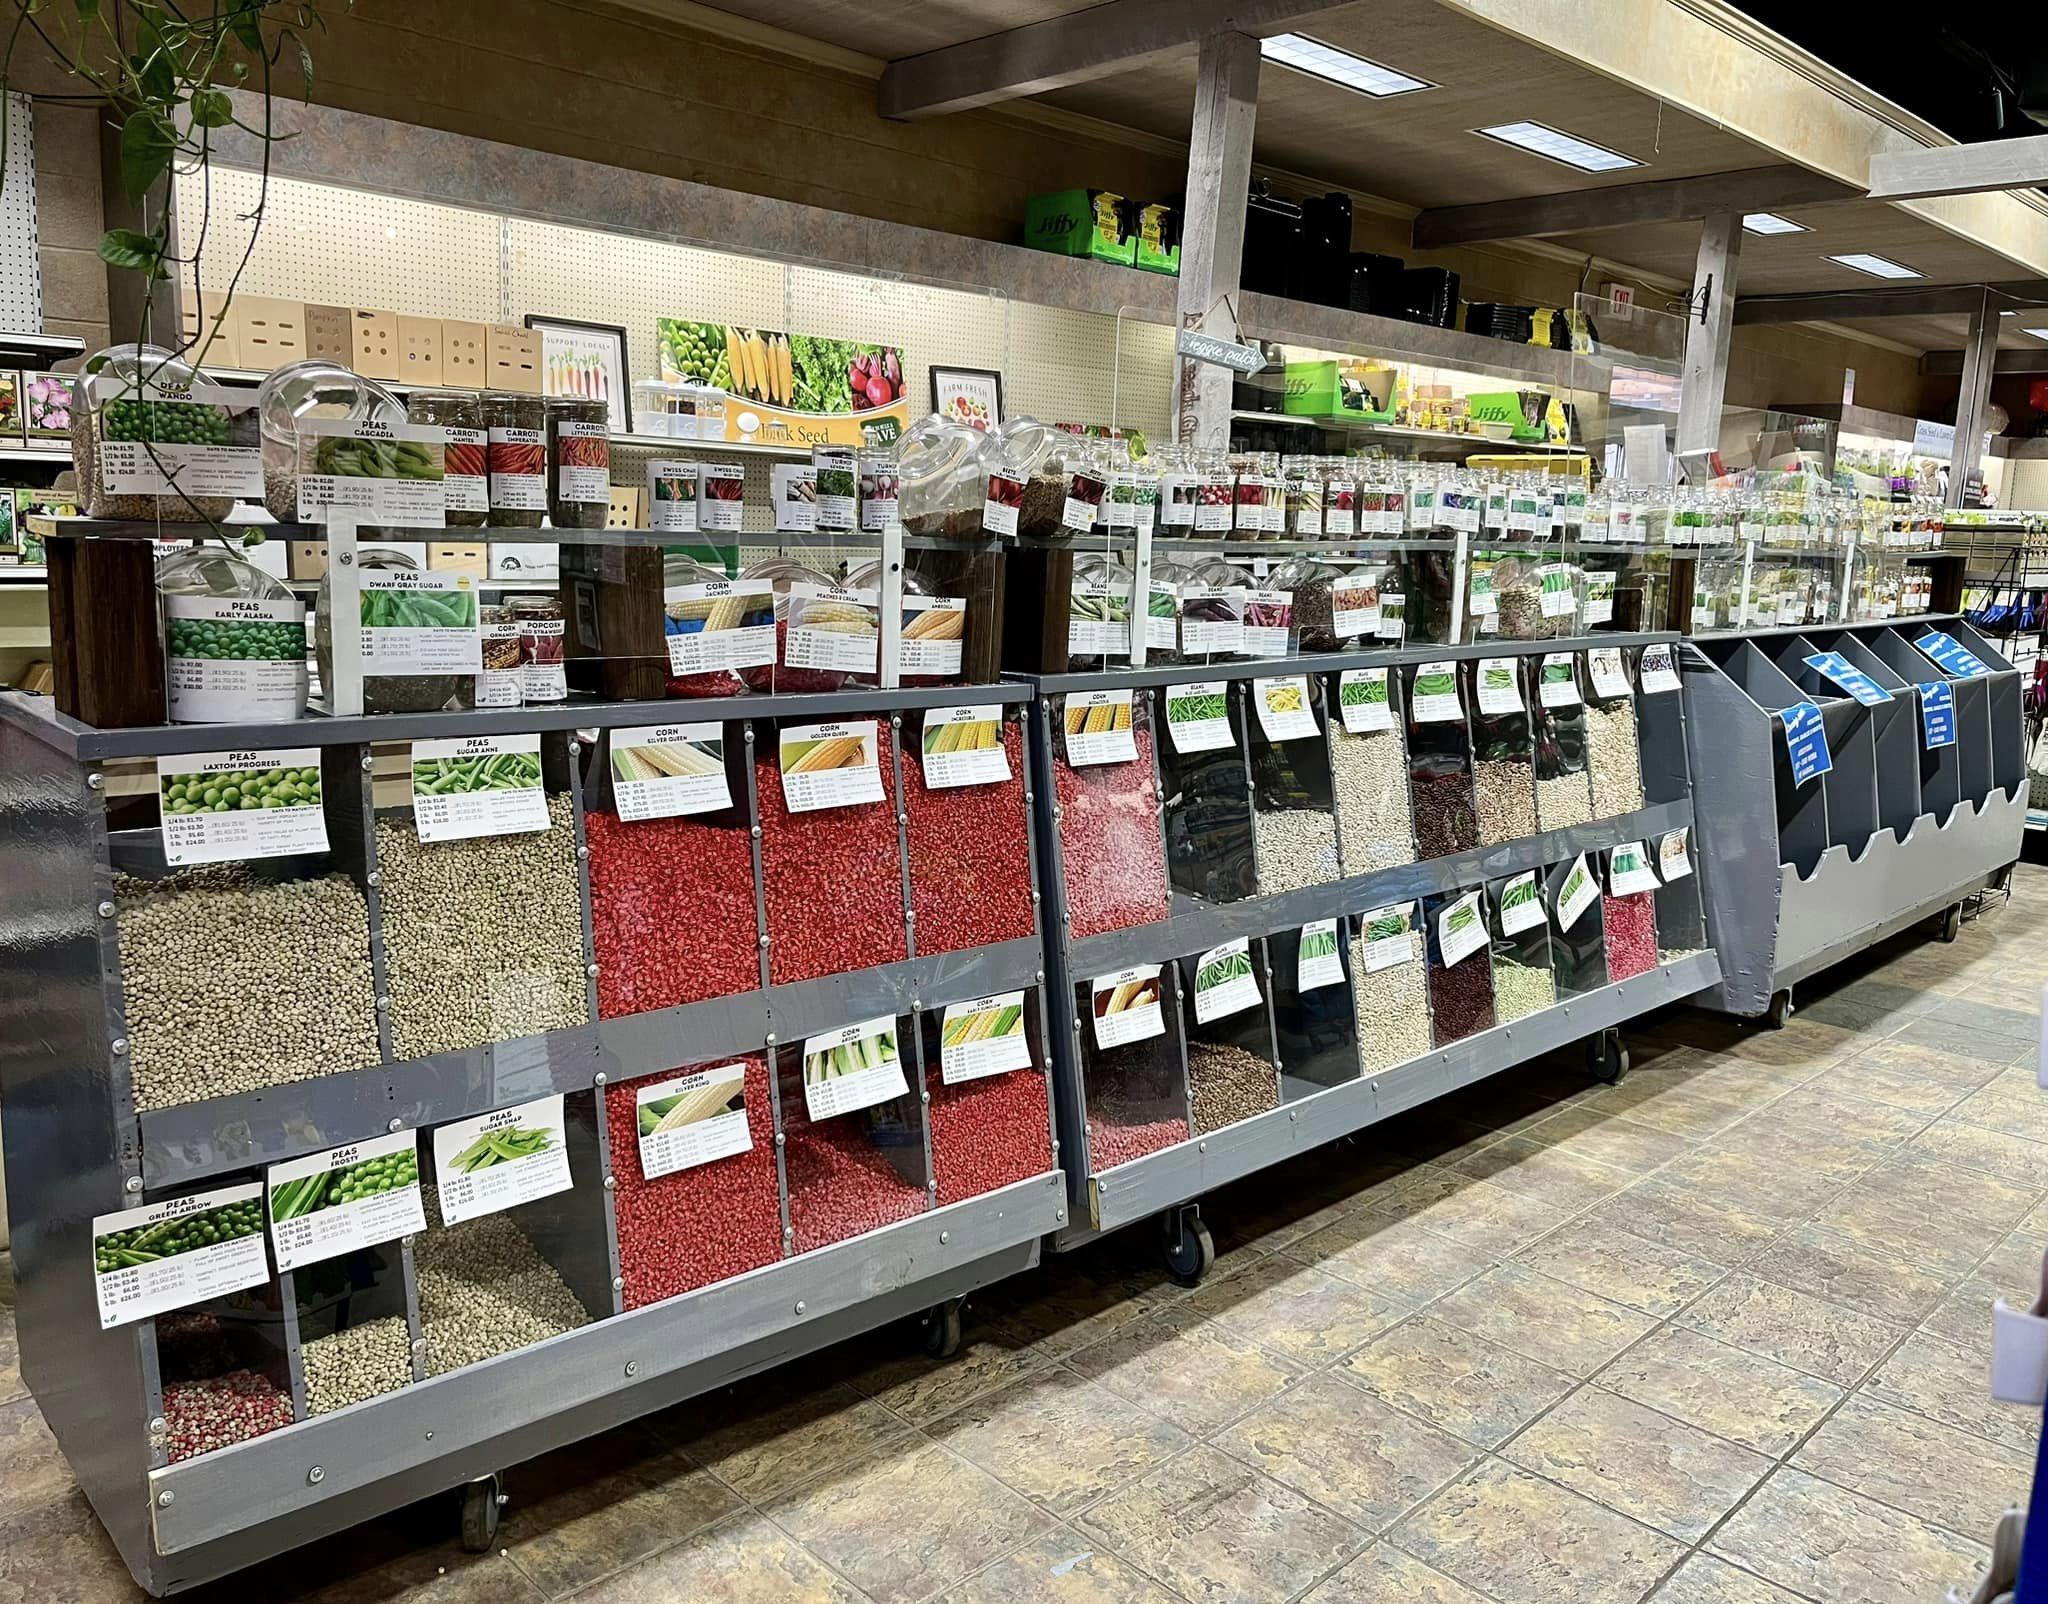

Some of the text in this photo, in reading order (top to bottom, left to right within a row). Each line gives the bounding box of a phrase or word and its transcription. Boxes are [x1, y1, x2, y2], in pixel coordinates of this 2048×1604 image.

[1036, 213, 1079, 234] Jiffy
[546, 337, 578, 347] SUPPORT
[1224, 350, 1258, 367] patch
[944, 383, 987, 397] FARM FRESH
[159, 392, 193, 400] WANDO
[1474, 407, 1513, 422] Jiffy
[362, 421, 388, 430] PEAS
[575, 424, 606, 433] CARROTS
[354, 430, 394, 438] CASCADIA
[446, 429, 479, 438] CARROTS
[506, 430, 539, 438] CARROTS
[798, 425, 829, 443] Seed
[394, 573, 419, 581] PEAS
[706, 582, 729, 591] CORN
[829, 586, 848, 594] CORN
[232, 602, 260, 611] PEAS
[243, 612, 274, 620] ALASKA
[656, 728, 679, 736] CORN
[820, 724, 840, 732] CORN
[467, 739, 489, 747] PEAS
[229, 752, 257, 761] PEAS
[203, 760, 281, 771] LAXTON PROGRESS
[977, 999, 994, 1007] CORN
[842, 1027, 860, 1037] CORN
[682, 1075, 704, 1085] CORN
[675, 1080, 710, 1094] SILVER KING
[490, 1111, 513, 1123] PEAS
[480, 1116, 522, 1132] SUGAR SNAP
[332, 1147, 358, 1159] PEAS
[330, 1155, 359, 1168] FROSTY
[166, 1197, 196, 1210] PEAS
[148, 1201, 212, 1221] GREEN ARROW
